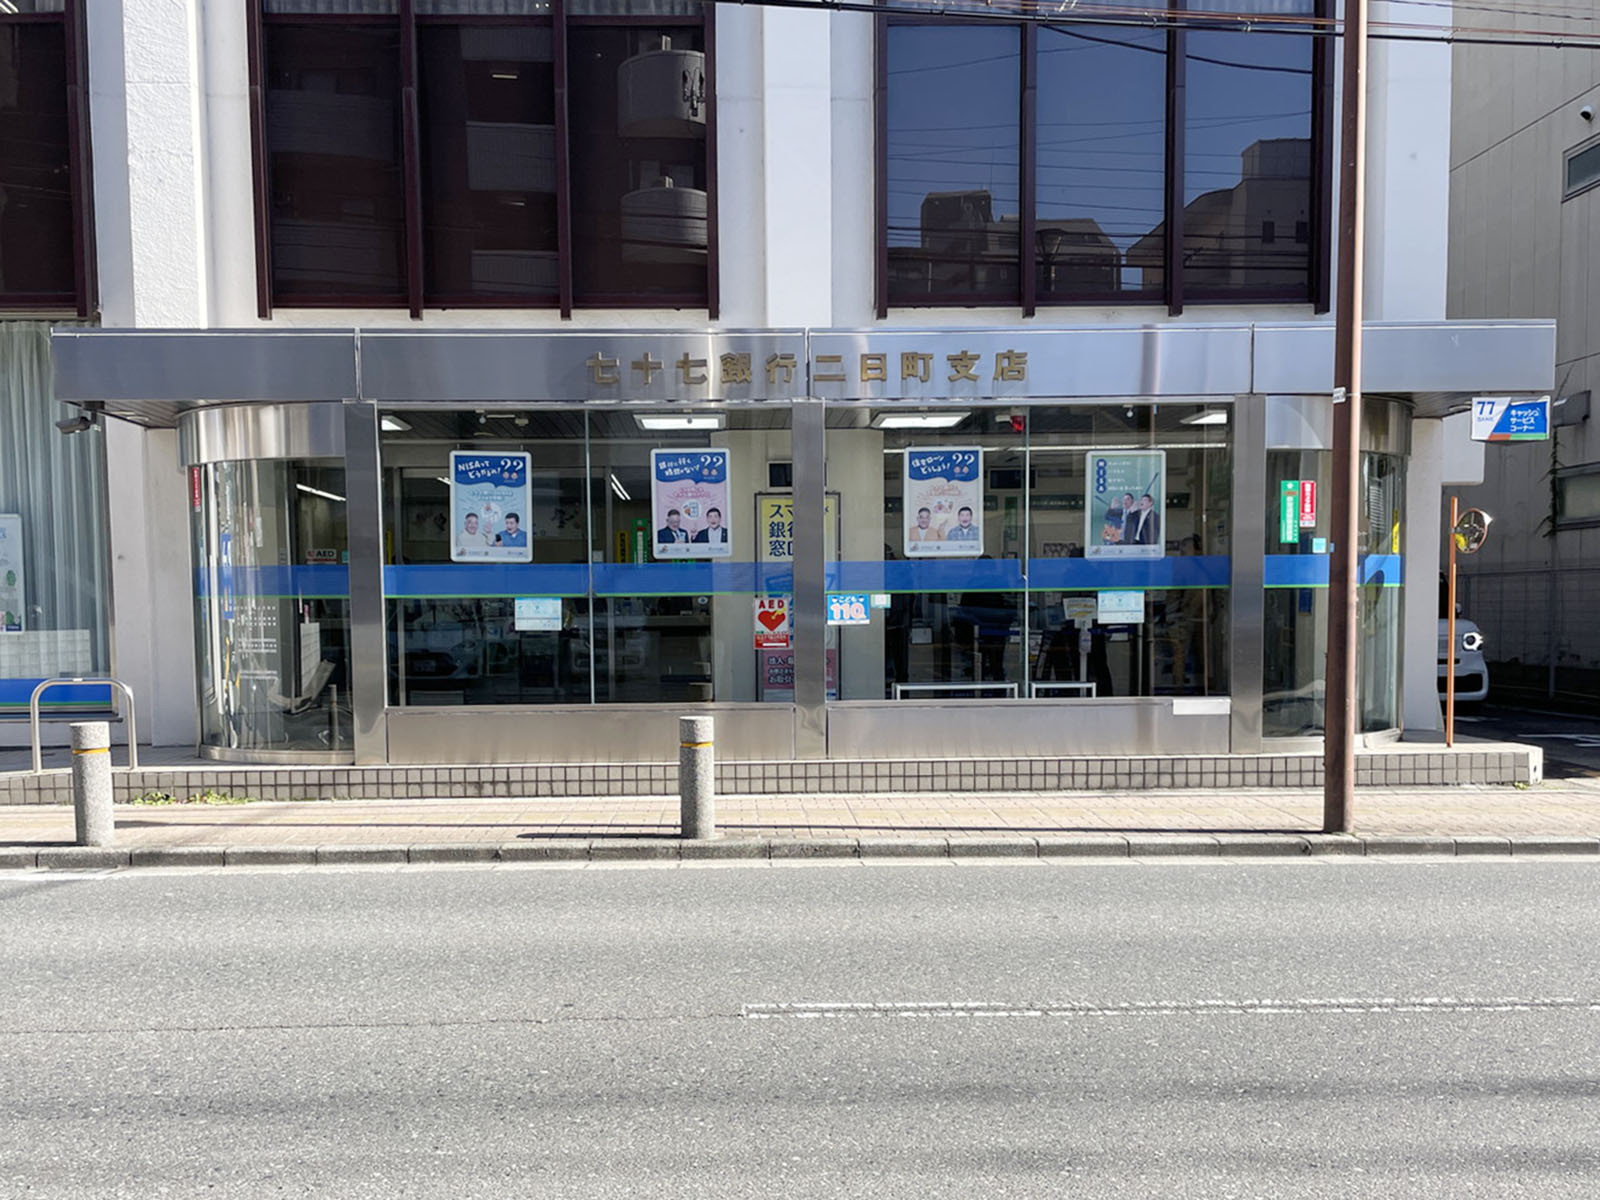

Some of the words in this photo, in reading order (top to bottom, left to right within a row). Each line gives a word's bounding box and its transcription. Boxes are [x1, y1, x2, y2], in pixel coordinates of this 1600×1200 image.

[587, 351, 1028, 384] 七十七銀行二日町支店
[1476, 401, 1496, 415] 77
[1510, 409, 1539, 417] キャッシュ
[1510, 416, 1535, 425] サービス
[758, 599, 785, 609] AED
